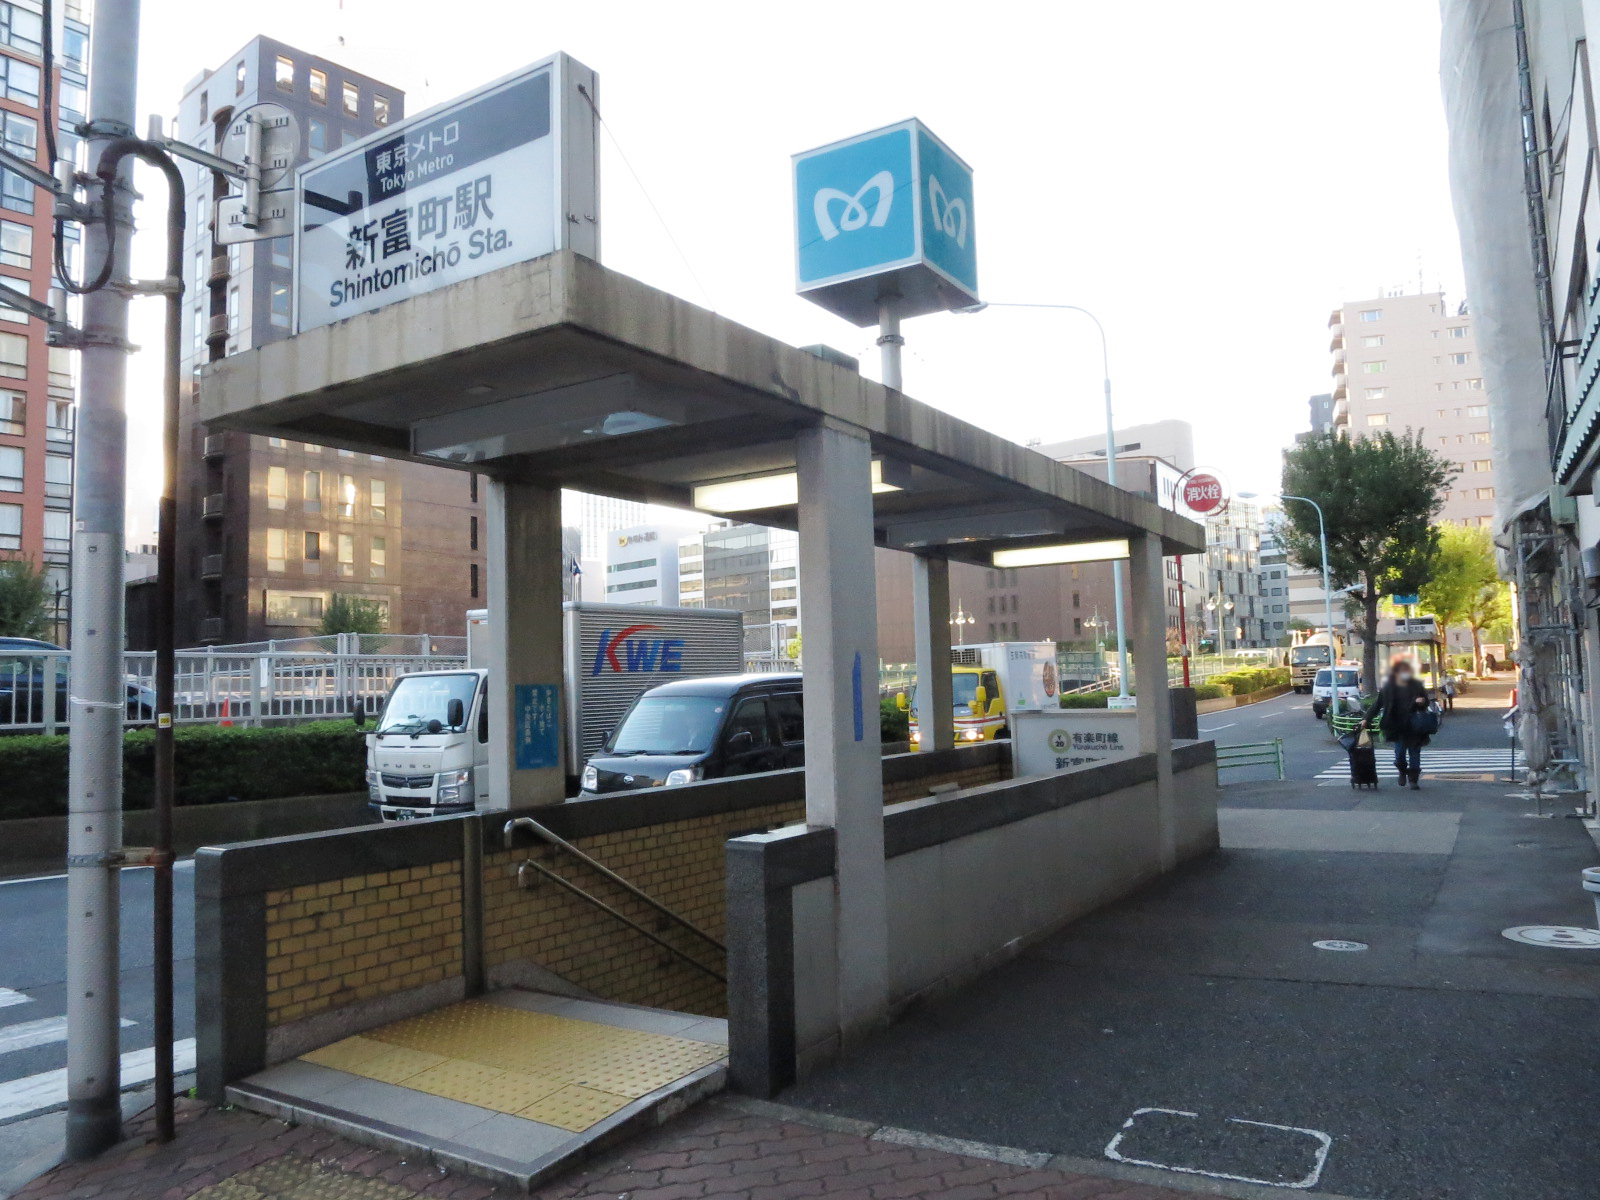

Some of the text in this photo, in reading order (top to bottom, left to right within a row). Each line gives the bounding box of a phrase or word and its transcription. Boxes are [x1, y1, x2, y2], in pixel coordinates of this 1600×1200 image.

[375, 121, 460, 175] 東京メトロ
[380, 153, 454, 193] Tokyo Metro
[345, 174, 494, 271] 新富町駅
[329, 226, 513, 307] Shintomichō Sta.
[1186, 484, 1219, 502] 消火栓
[592, 624, 685, 677] KWE
[1072, 732, 1119, 743] 有楽町線
